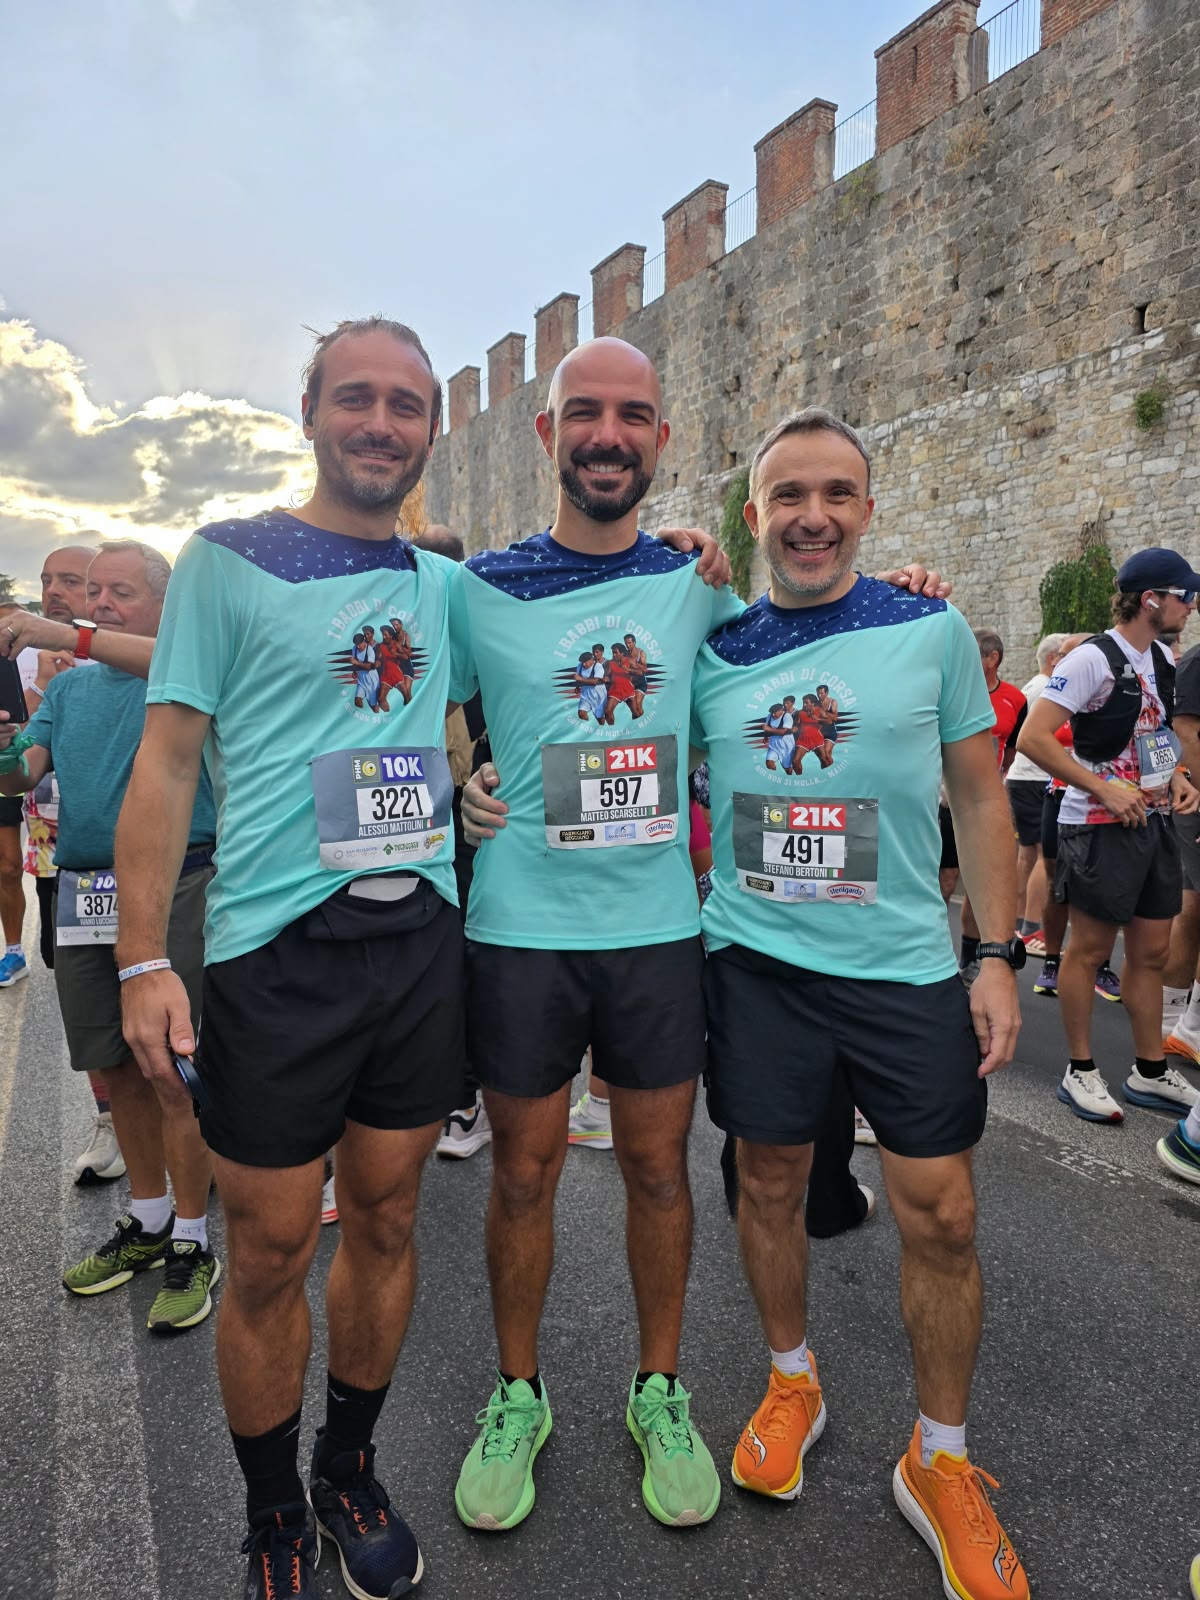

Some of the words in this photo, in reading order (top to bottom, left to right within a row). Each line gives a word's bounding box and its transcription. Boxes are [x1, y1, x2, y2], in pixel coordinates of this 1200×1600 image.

[331, 599, 371, 632] BABBI
[606, 616, 621, 628] DI
[558, 616, 600, 651] BABBI
[625, 619, 663, 660] CORSA
[553, 650, 567, 658] I
[753, 671, 795, 702] BABBI
[800, 668, 816, 681] DI
[818, 671, 857, 708] CORSA
[567, 714, 580, 727] QUI
[580, 721, 594, 734] NON
[1156, 735, 1170, 746] 10K
[382, 756, 423, 778] 10K
[609, 746, 655, 769] 21K
[1154, 749, 1174, 765] 3653
[354, 759, 362, 780] PHM
[755, 765, 767, 776] QUI
[767, 773, 783, 784] NON
[600, 777, 642, 807] 597
[371, 786, 424, 821] 3221
[580, 810, 608, 823] MATTEO
[610, 807, 647, 820] SCARSELLI
[792, 806, 843, 827] 21K
[358, 823, 389, 837] ALESSIO
[390, 819, 424, 833] MATTOLINI
[647, 822, 673, 833] sterilgarda
[781, 835, 824, 864] 491
[764, 863, 794, 877] STEFANO
[796, 867, 828, 878] BERTONI
[95, 875, 117, 889] 10
[830, 887, 863, 896] sterilgarda
